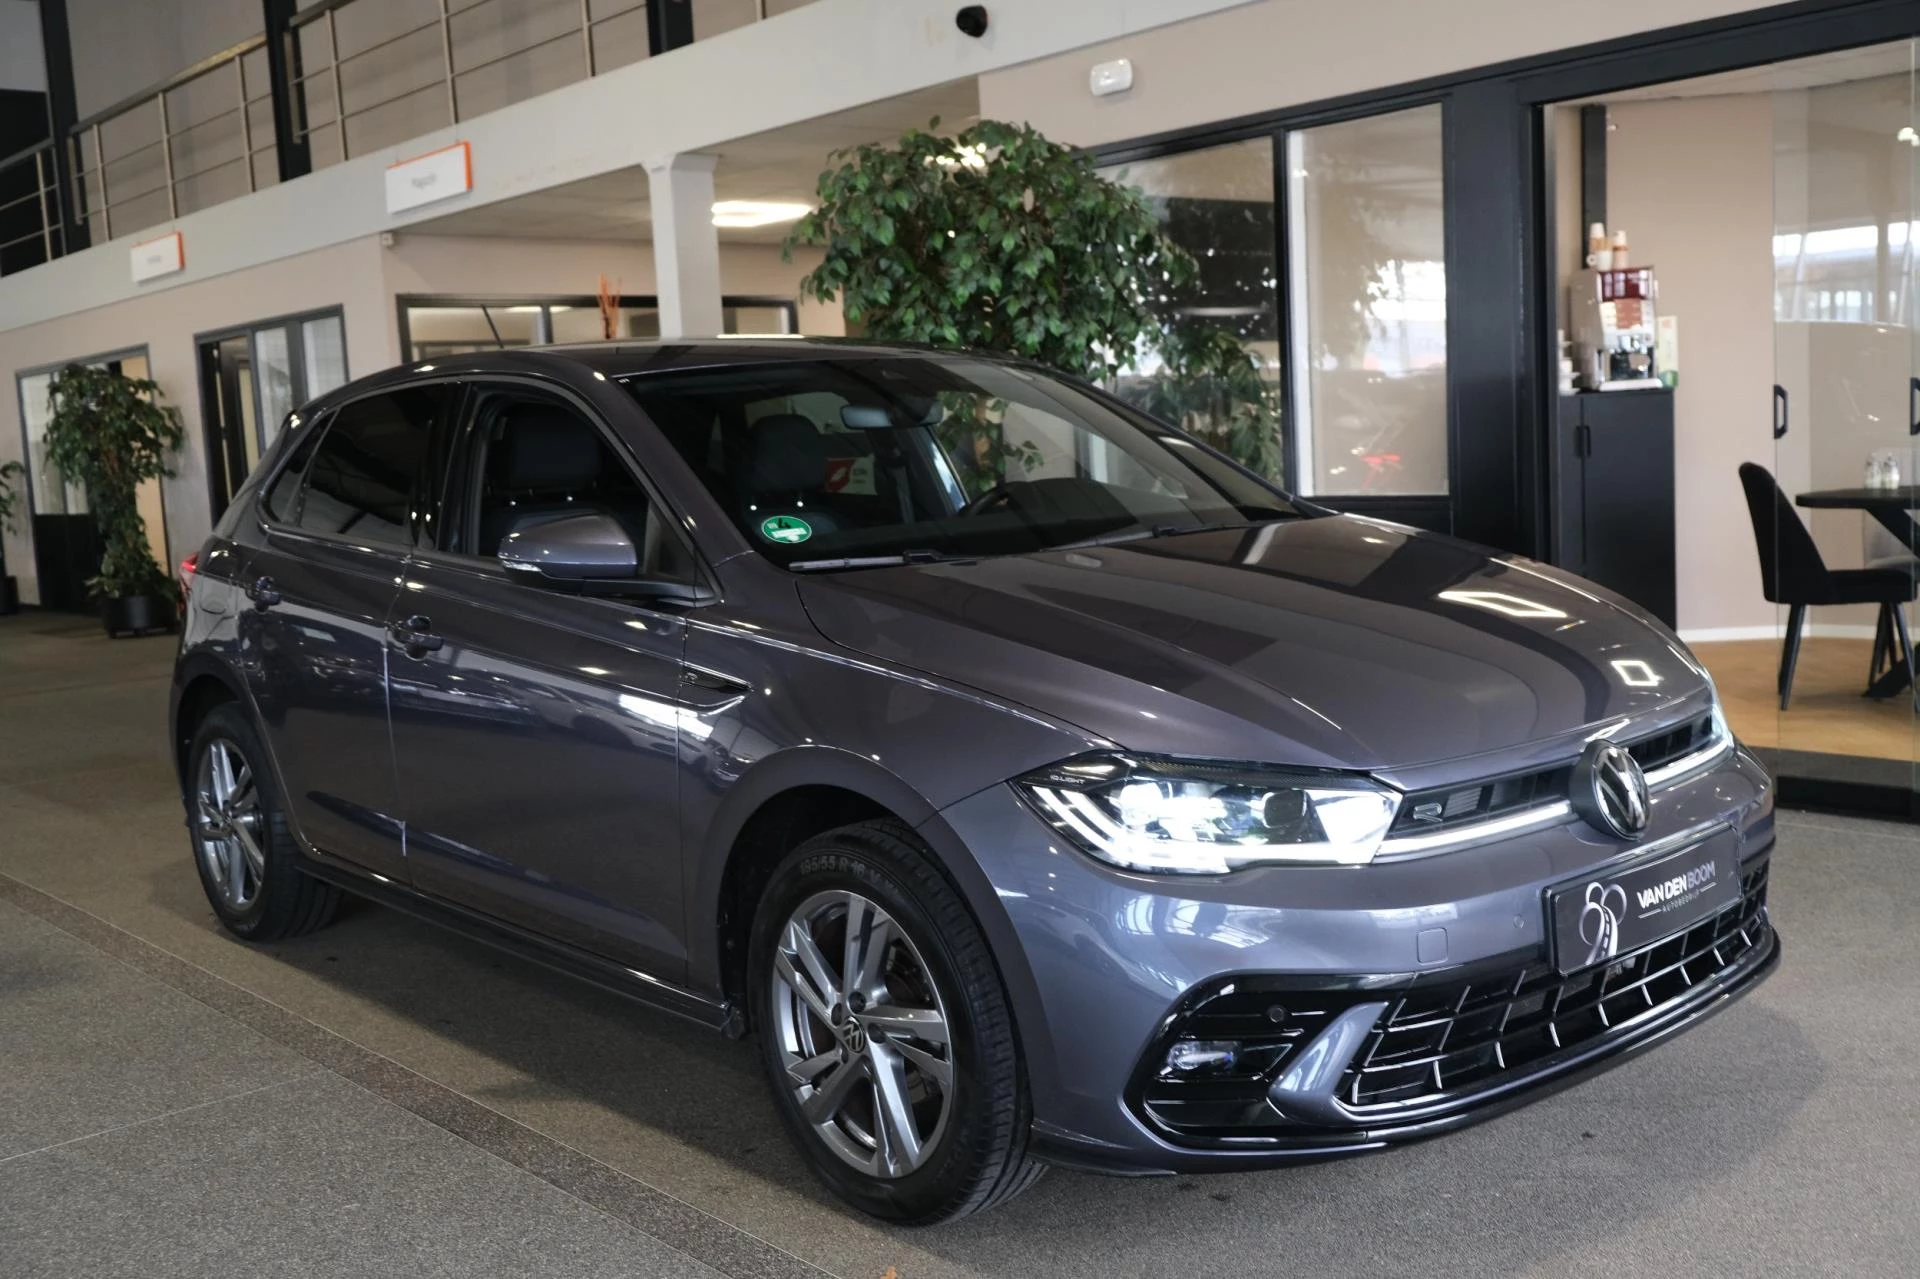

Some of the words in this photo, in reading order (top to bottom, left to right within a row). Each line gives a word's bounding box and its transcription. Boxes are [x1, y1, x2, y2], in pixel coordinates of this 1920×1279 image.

[1636, 885, 1665, 909] VAN
[1664, 874, 1687, 899] DEN
[1687, 861, 1715, 888] BOOM
